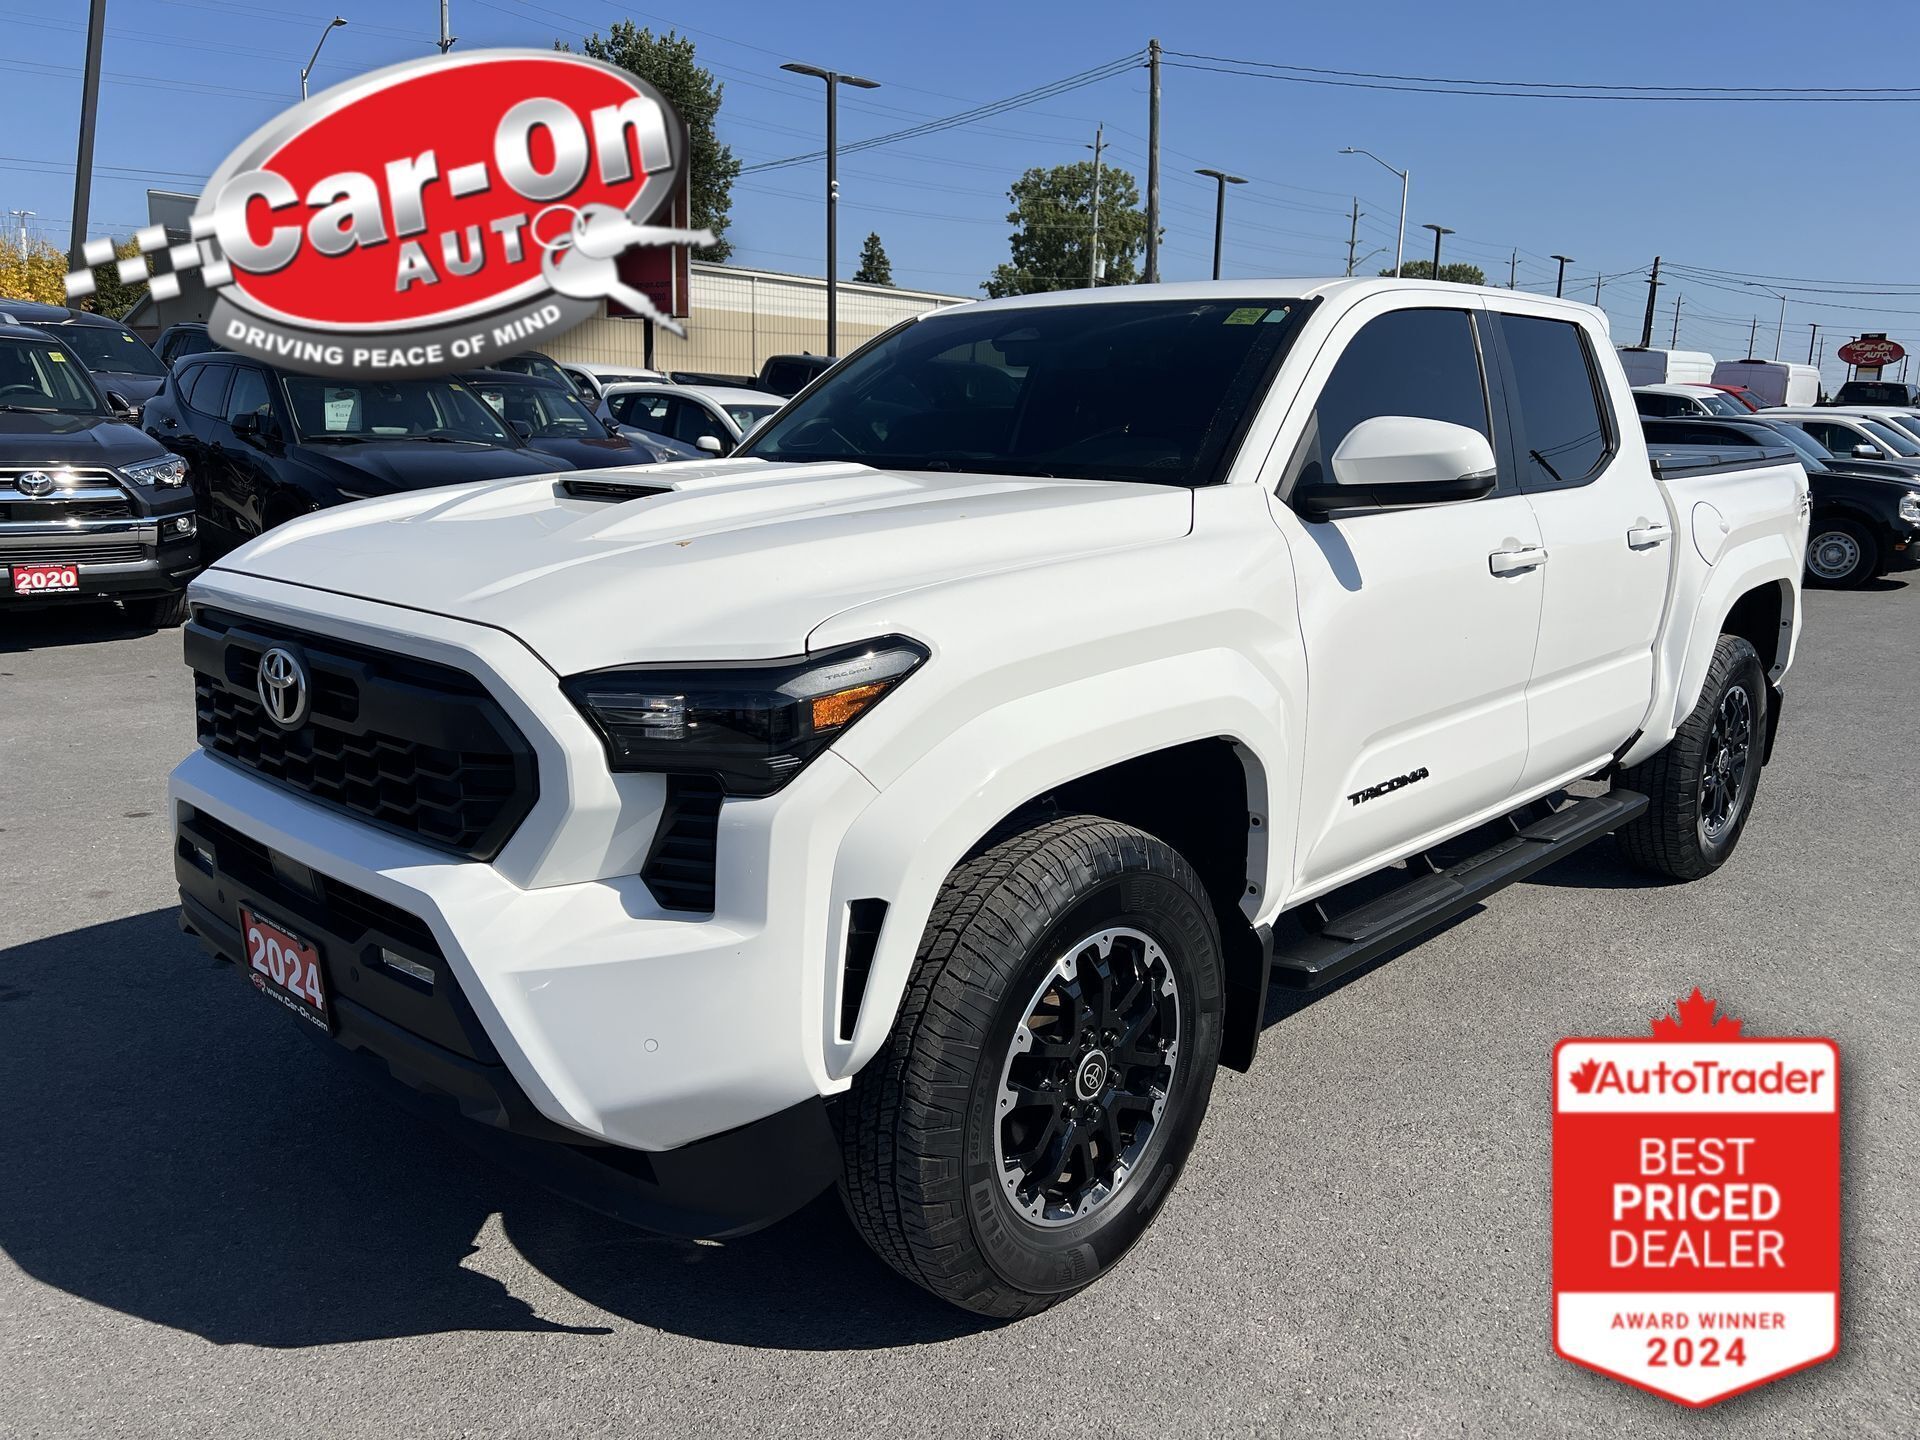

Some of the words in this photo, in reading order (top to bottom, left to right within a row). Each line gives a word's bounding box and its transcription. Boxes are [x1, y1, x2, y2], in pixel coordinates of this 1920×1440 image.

[1857, 342, 1893, 351] Car-On
[17, 571, 75, 588] 2020
[1346, 766, 1430, 807] TACOMA
[248, 927, 324, 1011] 2024
[266, 987, 328, 1032] www.Car-On.com
